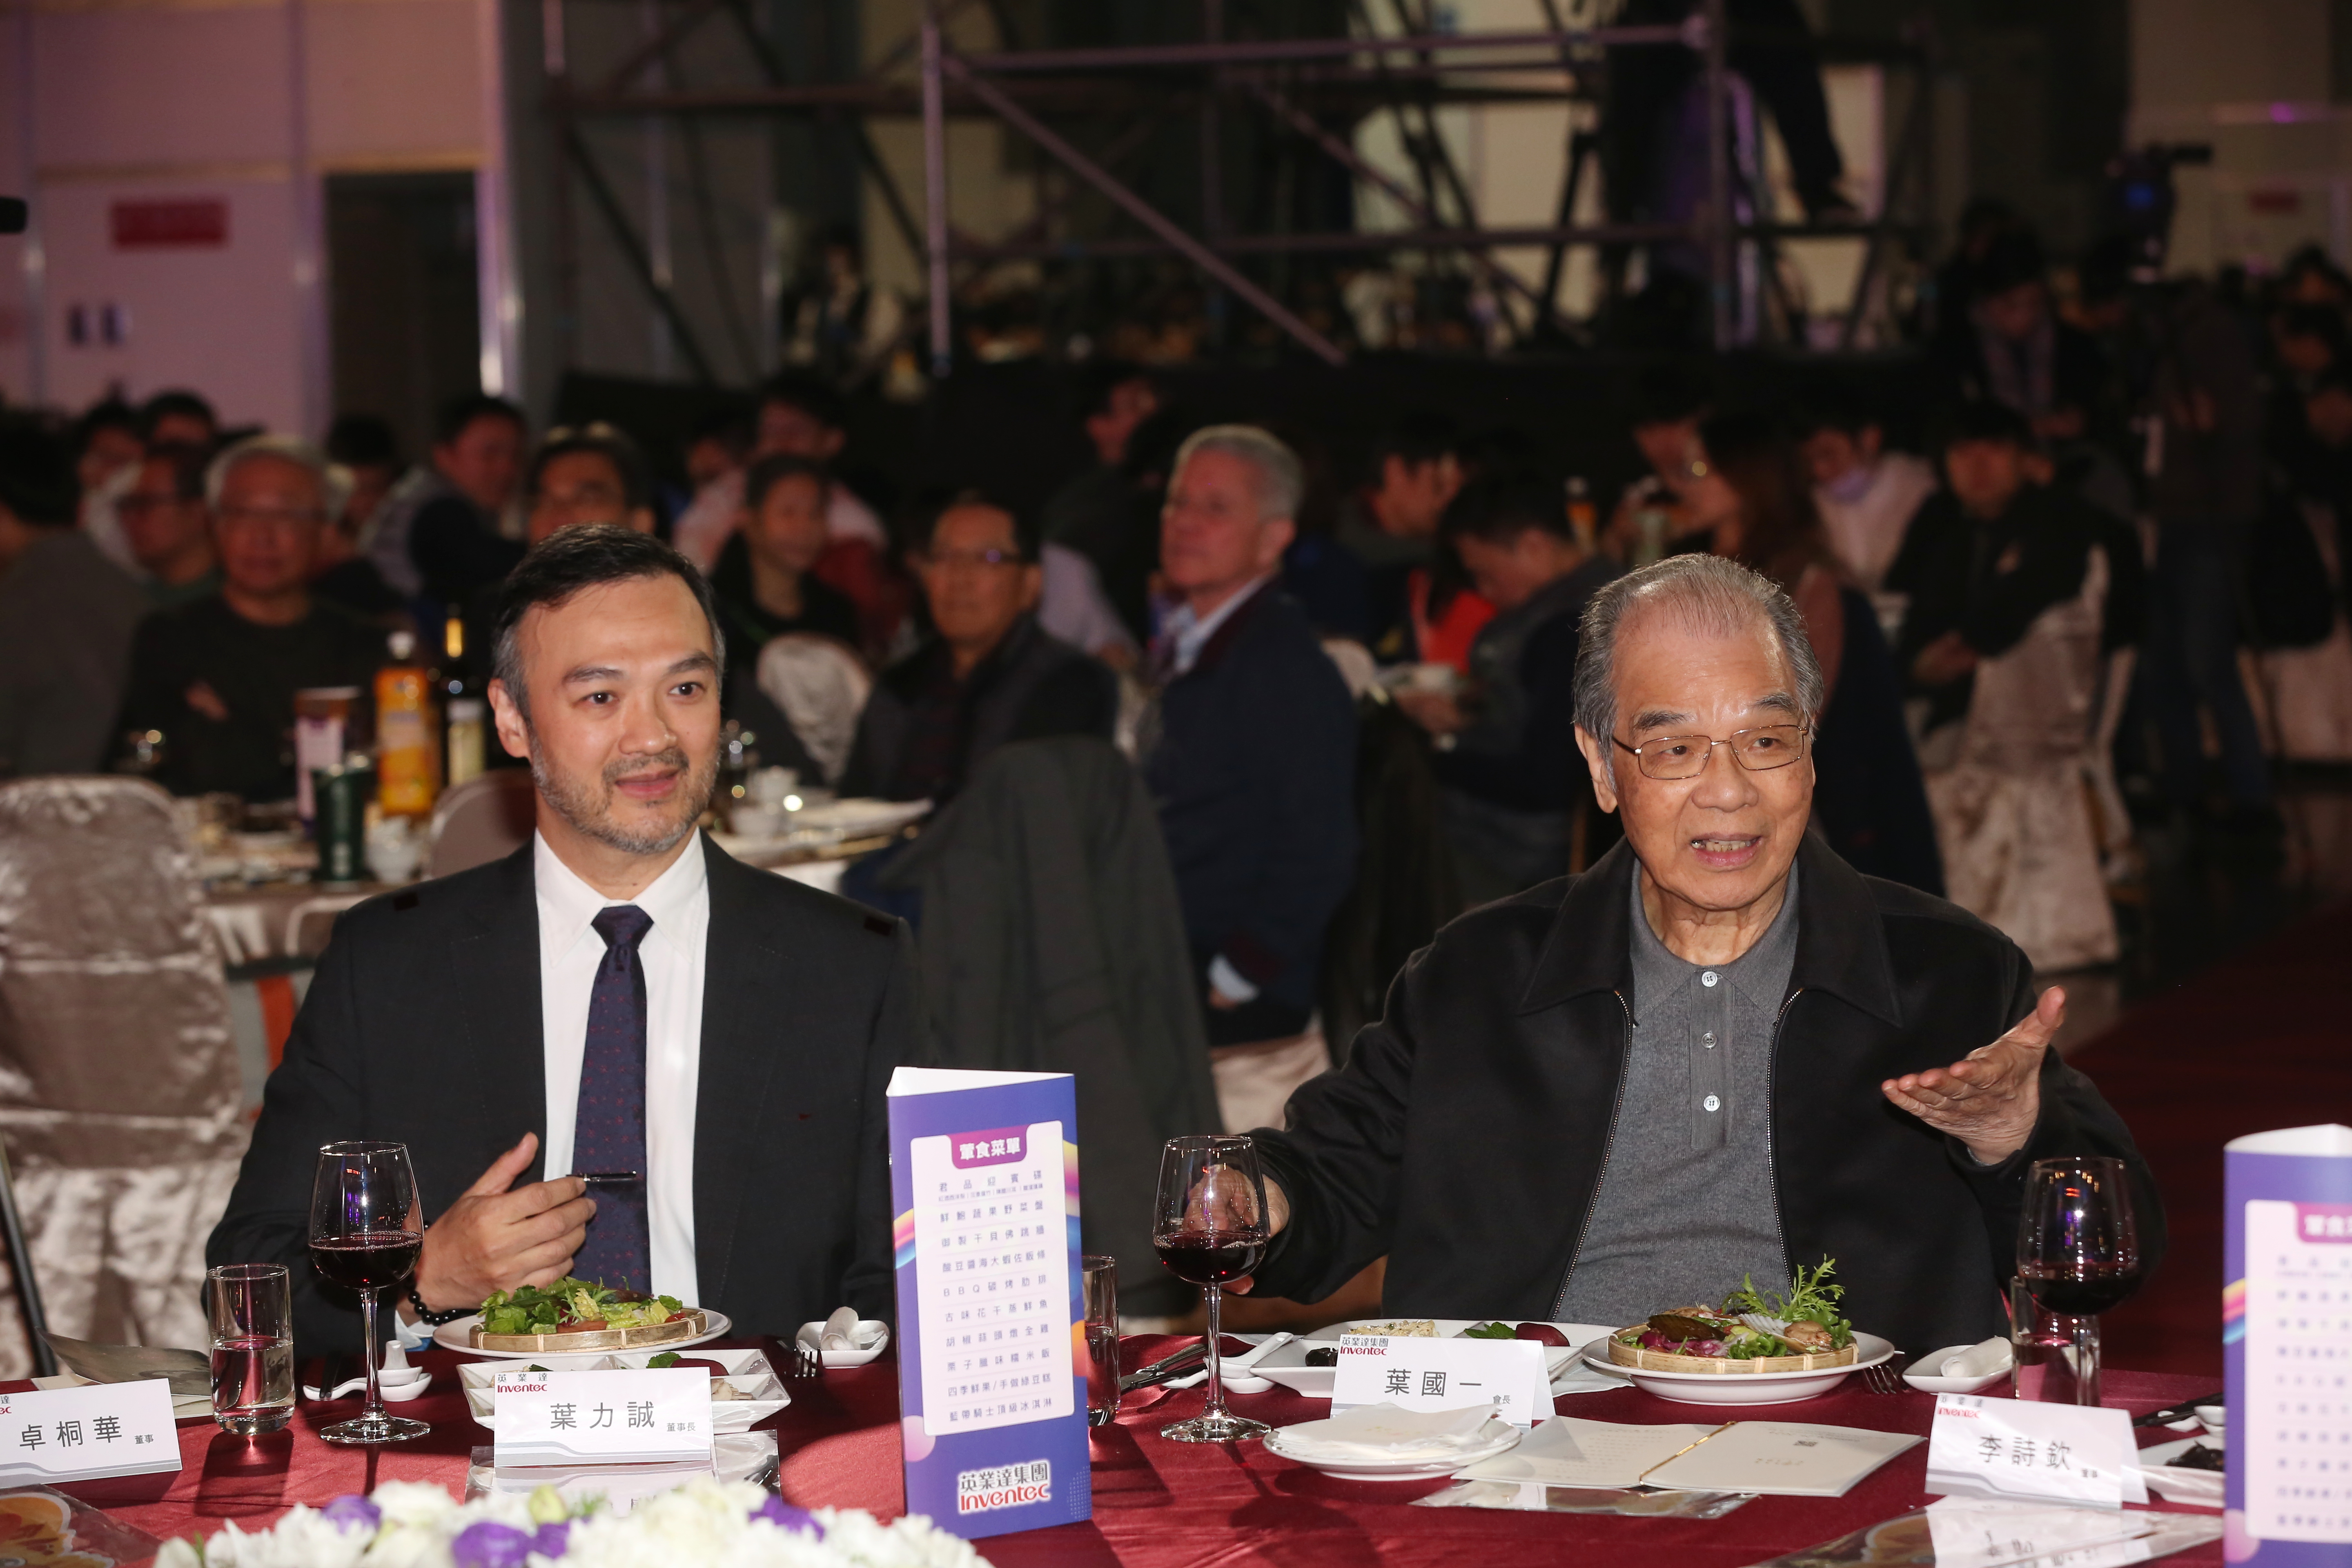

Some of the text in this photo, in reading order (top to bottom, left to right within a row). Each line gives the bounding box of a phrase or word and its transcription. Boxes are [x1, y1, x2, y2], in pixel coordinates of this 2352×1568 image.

[1341, 1336, 1389, 1347] 英業達集團
[497, 1372, 548, 1383] 英業達
[1384, 1368, 1482, 1397] 葉國一
[1492, 1394, 1511, 1405] 會長
[550, 1401, 655, 1431] 葉力誠
[19, 1415, 122, 1451] 卓桐華
[666, 1422, 697, 1433] 董事長
[134, 1434, 154, 1445] 董事
[1978, 1434, 2072, 1470] 李詩欽
[960, 1461, 1049, 1492] 英業達集團
